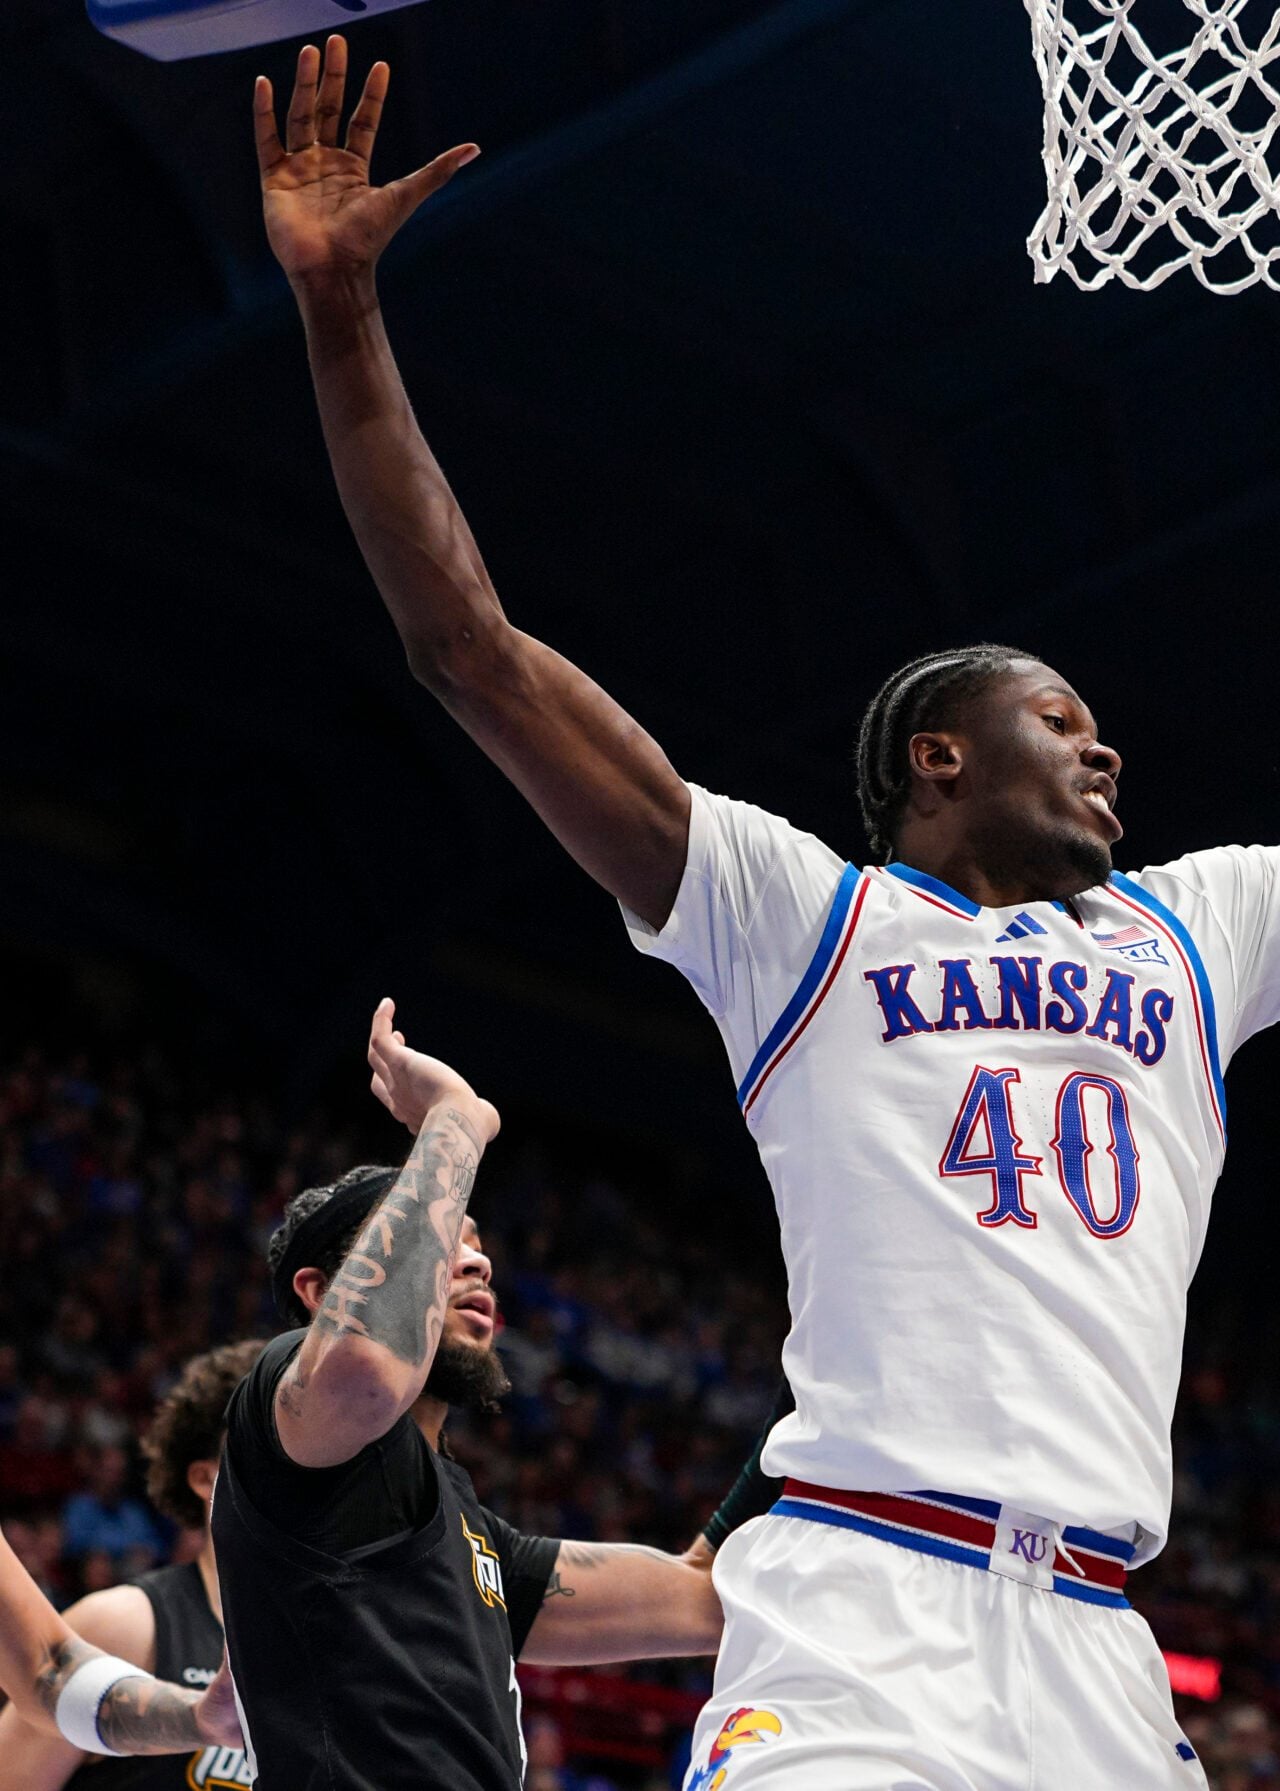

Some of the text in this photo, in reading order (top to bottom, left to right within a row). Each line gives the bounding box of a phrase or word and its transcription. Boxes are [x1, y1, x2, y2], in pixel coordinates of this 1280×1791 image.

[864, 956, 1175, 1066] KANSAS
[939, 1064, 1140, 1240] 40
[1008, 1528, 1048, 1564] KU
